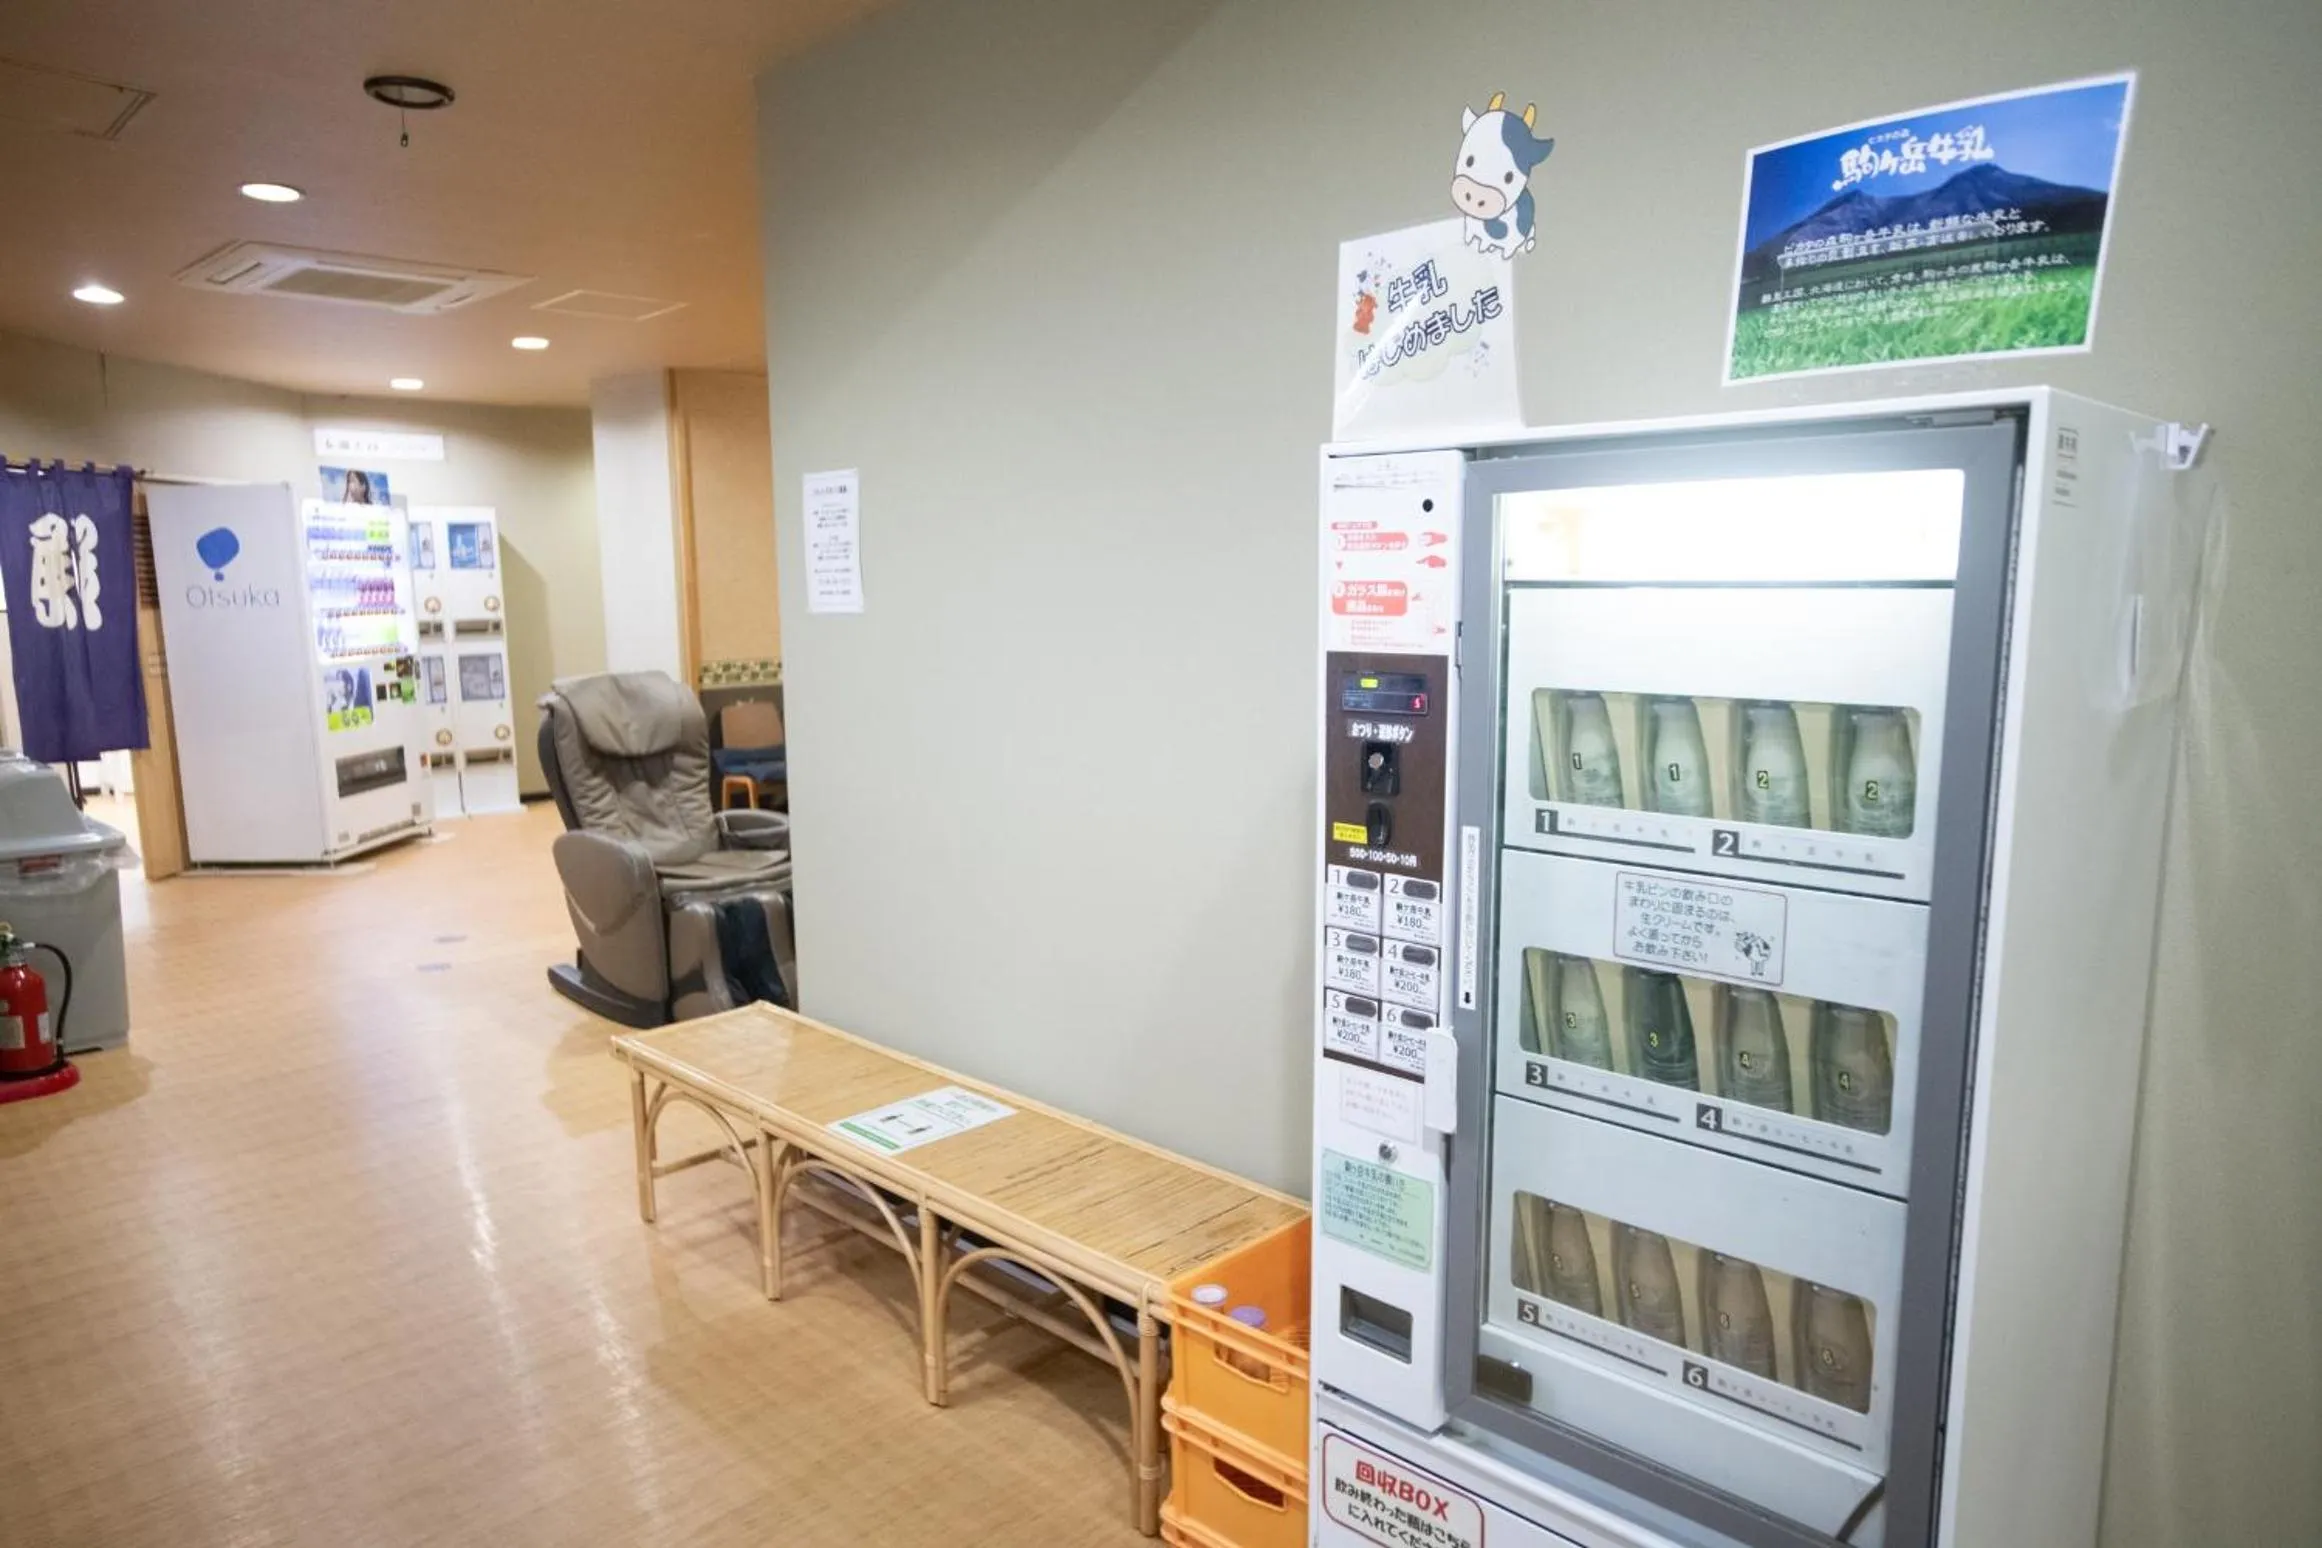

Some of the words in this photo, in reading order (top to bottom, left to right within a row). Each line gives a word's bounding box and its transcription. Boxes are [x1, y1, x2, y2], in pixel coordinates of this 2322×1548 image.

[1387, 259, 1448, 314] 牛乳
[1358, 286, 1503, 379] はじめました
[186, 583, 281, 609] Otsuka
[1574, 754, 1582, 769] 1
[1671, 764, 1680, 781] 1
[1758, 772, 1768, 788] 2
[1866, 783, 1878, 798] 2
[1541, 811, 1550, 832] 1
[1717, 832, 1734, 855] 2
[1334, 870, 1341, 883] 1
[1390, 879, 1399, 894] 2
[1624, 881, 1733, 905] 牛乳ビンの飲み口の
[1338, 904, 1361, 917] ¥180
[1397, 915, 1422, 928] ¥180
[1640, 913, 1720, 936] 生クリームです。
[1332, 932, 1340, 947] 3
[1388, 944, 1397, 958] 4
[1338, 967, 1361, 980] ¥180
[1395, 980, 1419, 994] ¥200
[1332, 994, 1340, 1008] 5
[1387, 1008, 1396, 1022] 6
[1567, 1014, 1576, 1028] 3
[1337, 1030, 1360, 1043] ¥200
[1649, 1032, 1658, 1047] 3
[1393, 1045, 1418, 1059] ¥200
[1530, 1064, 1543, 1085] 3
[1700, 1109, 1717, 1130] 4
[1522, 1303, 1535, 1322] 5
[1687, 1367, 1703, 1387] 6
[1355, 1459, 1449, 1522] 回収BOX
